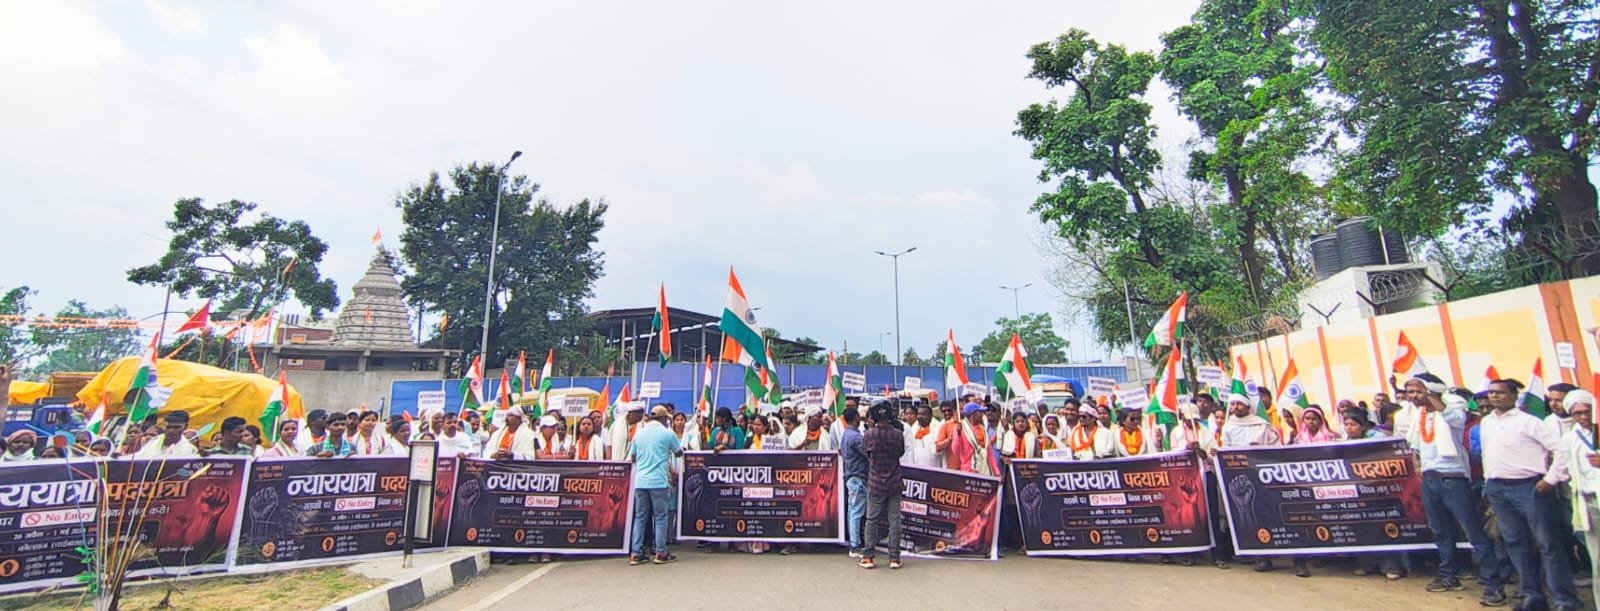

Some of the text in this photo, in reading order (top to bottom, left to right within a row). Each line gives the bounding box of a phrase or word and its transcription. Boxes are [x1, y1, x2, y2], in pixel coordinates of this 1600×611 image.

[487, 471, 603, 493] न्याययात्रा पदयात्रा
[707, 466, 812, 484] न्याययात्रा पदयात्रा
[1044, 469, 1121, 491] न्याययात्रा
[1123, 471, 1170, 488] पदयात्रा
[1256, 459, 1349, 485] न्याययात्रा
[1350, 458, 1407, 479] पदयात्रा
[107, 480, 190, 500] पदयात्रा
[287, 472, 377, 496] न्याययात्रा
[381, 475, 407, 492] पदय
[931, 487, 970, 508] पदयात्रा
[46, 511, 92, 522] No Entry
